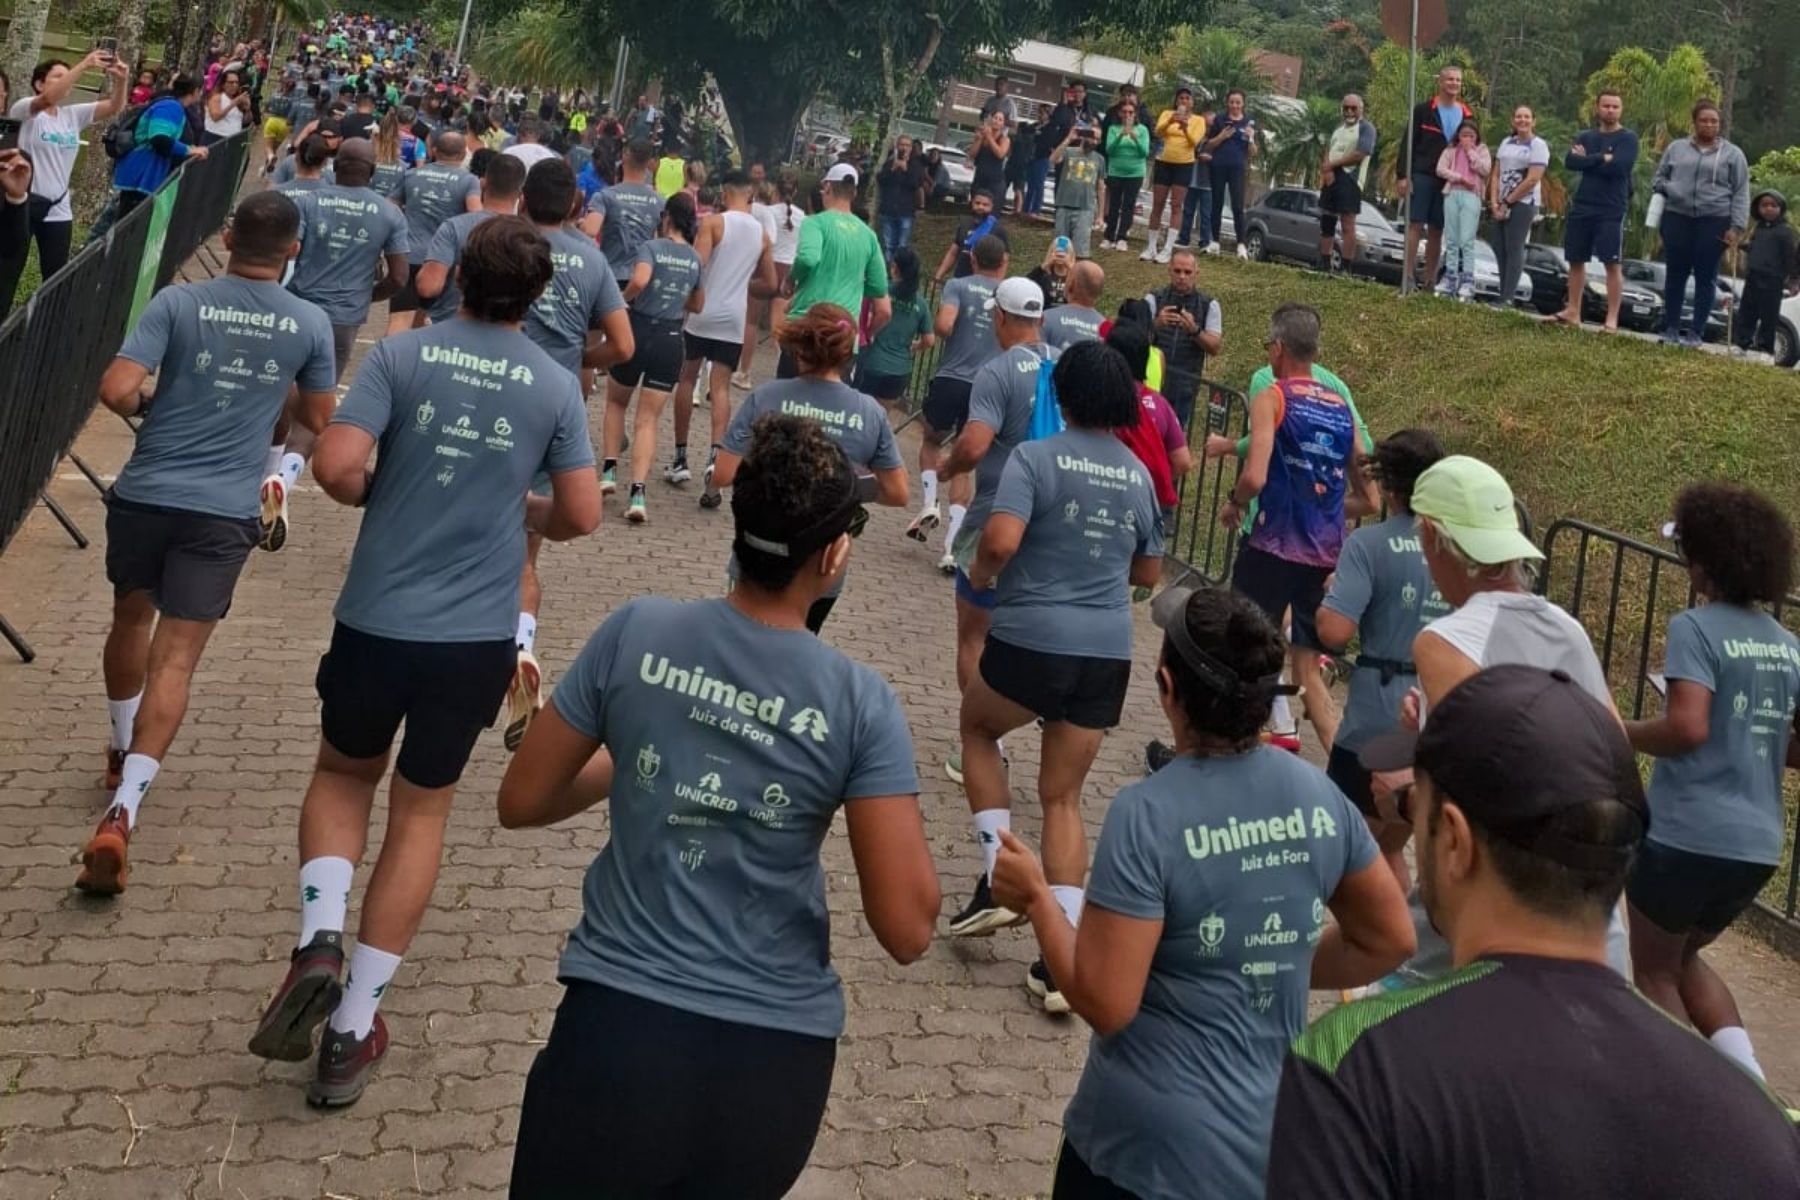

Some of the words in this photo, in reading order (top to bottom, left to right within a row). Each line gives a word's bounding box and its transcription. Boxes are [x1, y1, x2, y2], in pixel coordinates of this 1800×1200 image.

[199, 305, 276, 328] Unimed
[421, 345, 508, 376] Unimed
[782, 399, 846, 425] Unimed
[1057, 455, 1127, 481] Unimed
[640, 652, 785, 726] Unimed
[688, 706, 718, 726] Juiz
[720, 716, 739, 734] de
[741, 723, 775, 746] Fora
[674, 781, 739, 812] UNICRED
[1184, 807, 1307, 860] Unimed
[1241, 855, 1264, 872] Juiz
[1265, 851, 1281, 867] de
[1283, 849, 1310, 865] Fora
[1244, 929, 1299, 947] UNICRED
